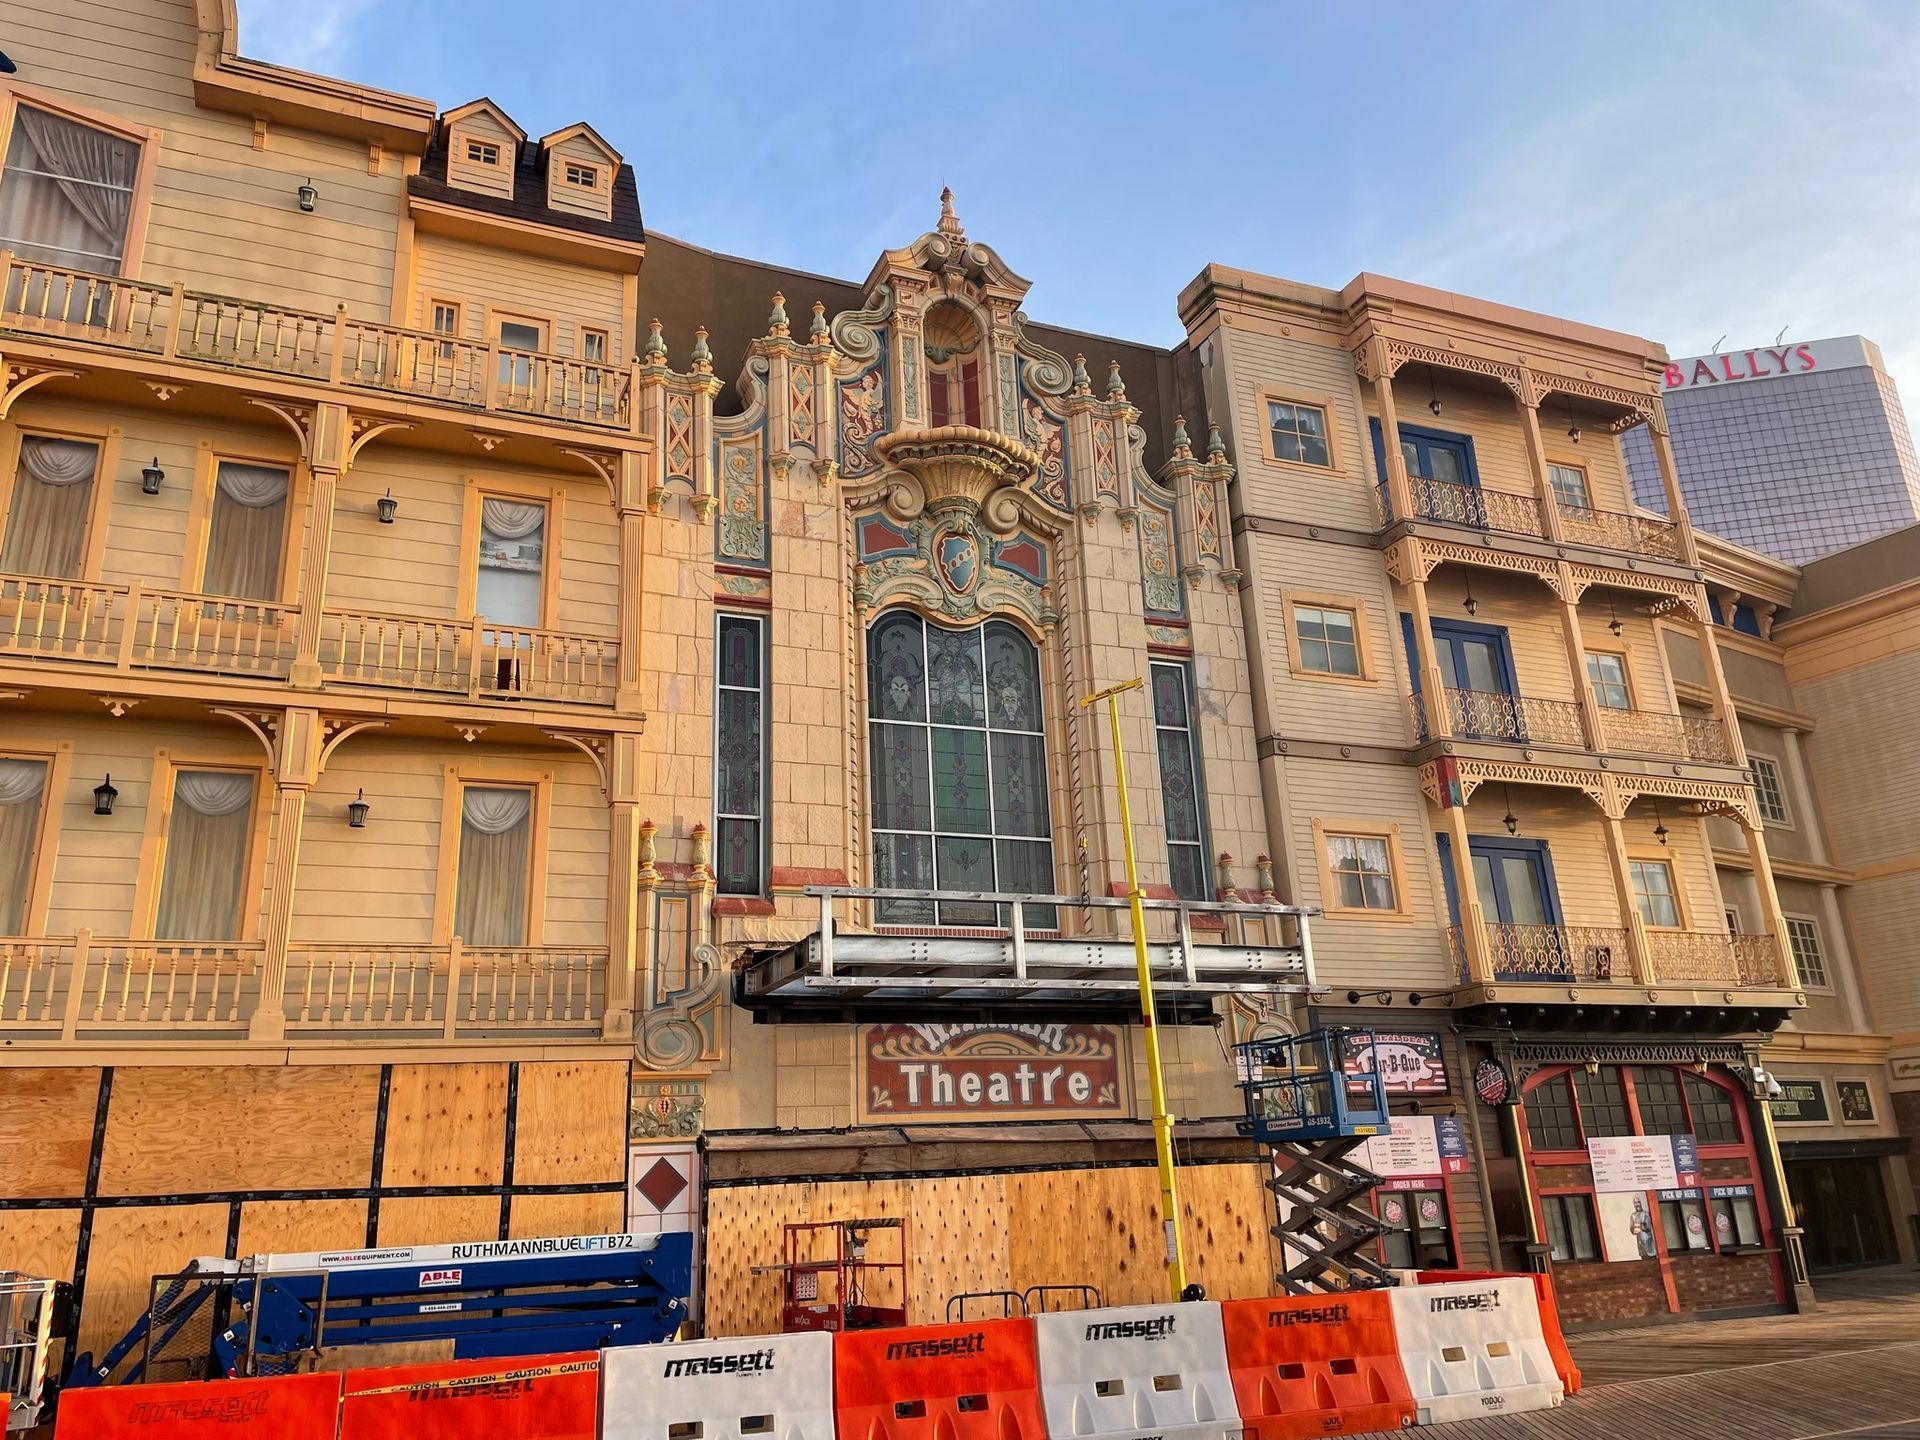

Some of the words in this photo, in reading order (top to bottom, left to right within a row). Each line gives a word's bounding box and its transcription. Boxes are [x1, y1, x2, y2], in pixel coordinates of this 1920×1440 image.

[1664, 344, 1816, 389] BALLYS
[1367, 1054, 1421, 1073] Br-B-Que
[900, 1062, 1091, 1105] Theatre
[1392, 1181, 1410, 1189] ORDER
[1411, 1180, 1425, 1188] HERE
[1662, 1191, 1673, 1199] PICK
[1675, 1190, 1682, 1198] UP
[1684, 1189, 1696, 1198] HERE
[1714, 1188, 1726, 1196] PICK
[1726, 1187, 1734, 1195] UP
[1735, 1186, 1748, 1195] HERE
[608, 1236, 632, 1248] B72
[422, 1271, 460, 1282] ABLE
[449, 1375, 496, 1386] CAUTION
[505, 1367, 551, 1380] CAUTION
